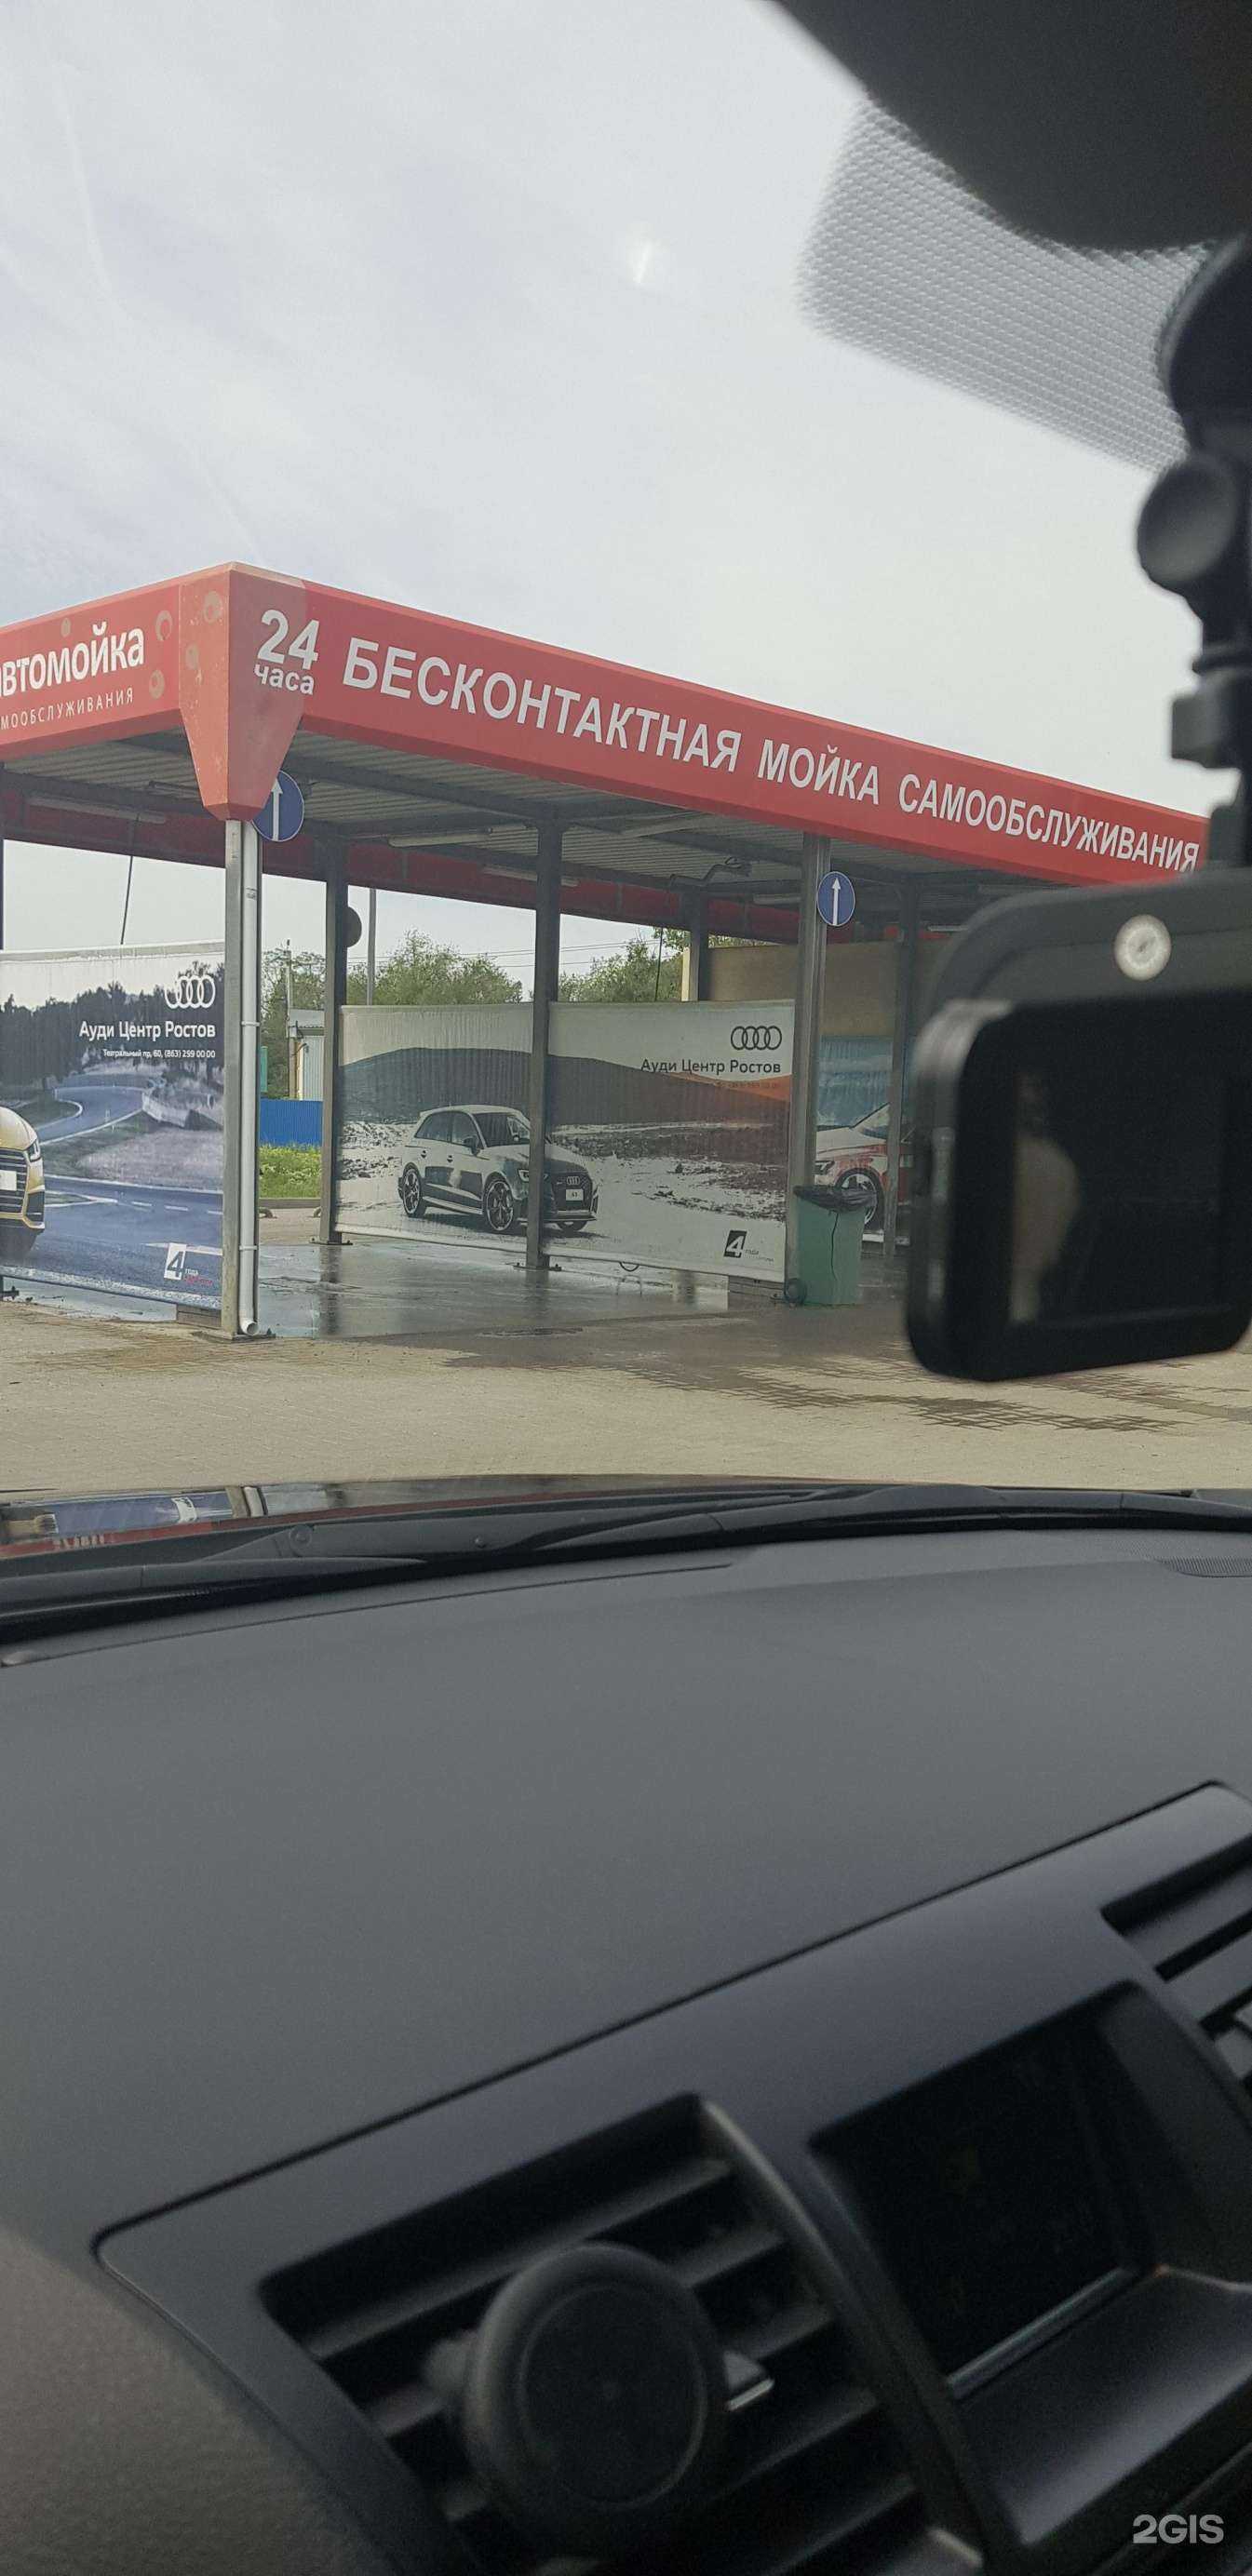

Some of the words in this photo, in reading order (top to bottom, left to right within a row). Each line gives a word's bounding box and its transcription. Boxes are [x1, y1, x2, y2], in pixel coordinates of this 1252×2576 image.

[257, 609, 320, 670] 24
[0, 621, 145, 697] втомойка
[254, 662, 315, 695] часа
[343, 637, 742, 772] БЕСКОНТАКТНАЯ
[758, 739, 880, 805] МОЙКА
[898, 773, 1200, 873] САМООБСЛУЖИВАНИЯ
[79, 1020, 114, 1041] Ауди
[118, 1021, 161, 1041] Центр
[165, 1021, 216, 1038] Ростов
[164, 1049, 182, 1059] (863)
[182, 1049, 195, 1058] 299
[640, 1058, 677, 1073] Ауди
[681, 1059, 725, 1075] Центр
[730, 1059, 781, 1073] Ростов
[725, 1234, 745, 1257] 4
[166, 1248, 185, 1279] 4
